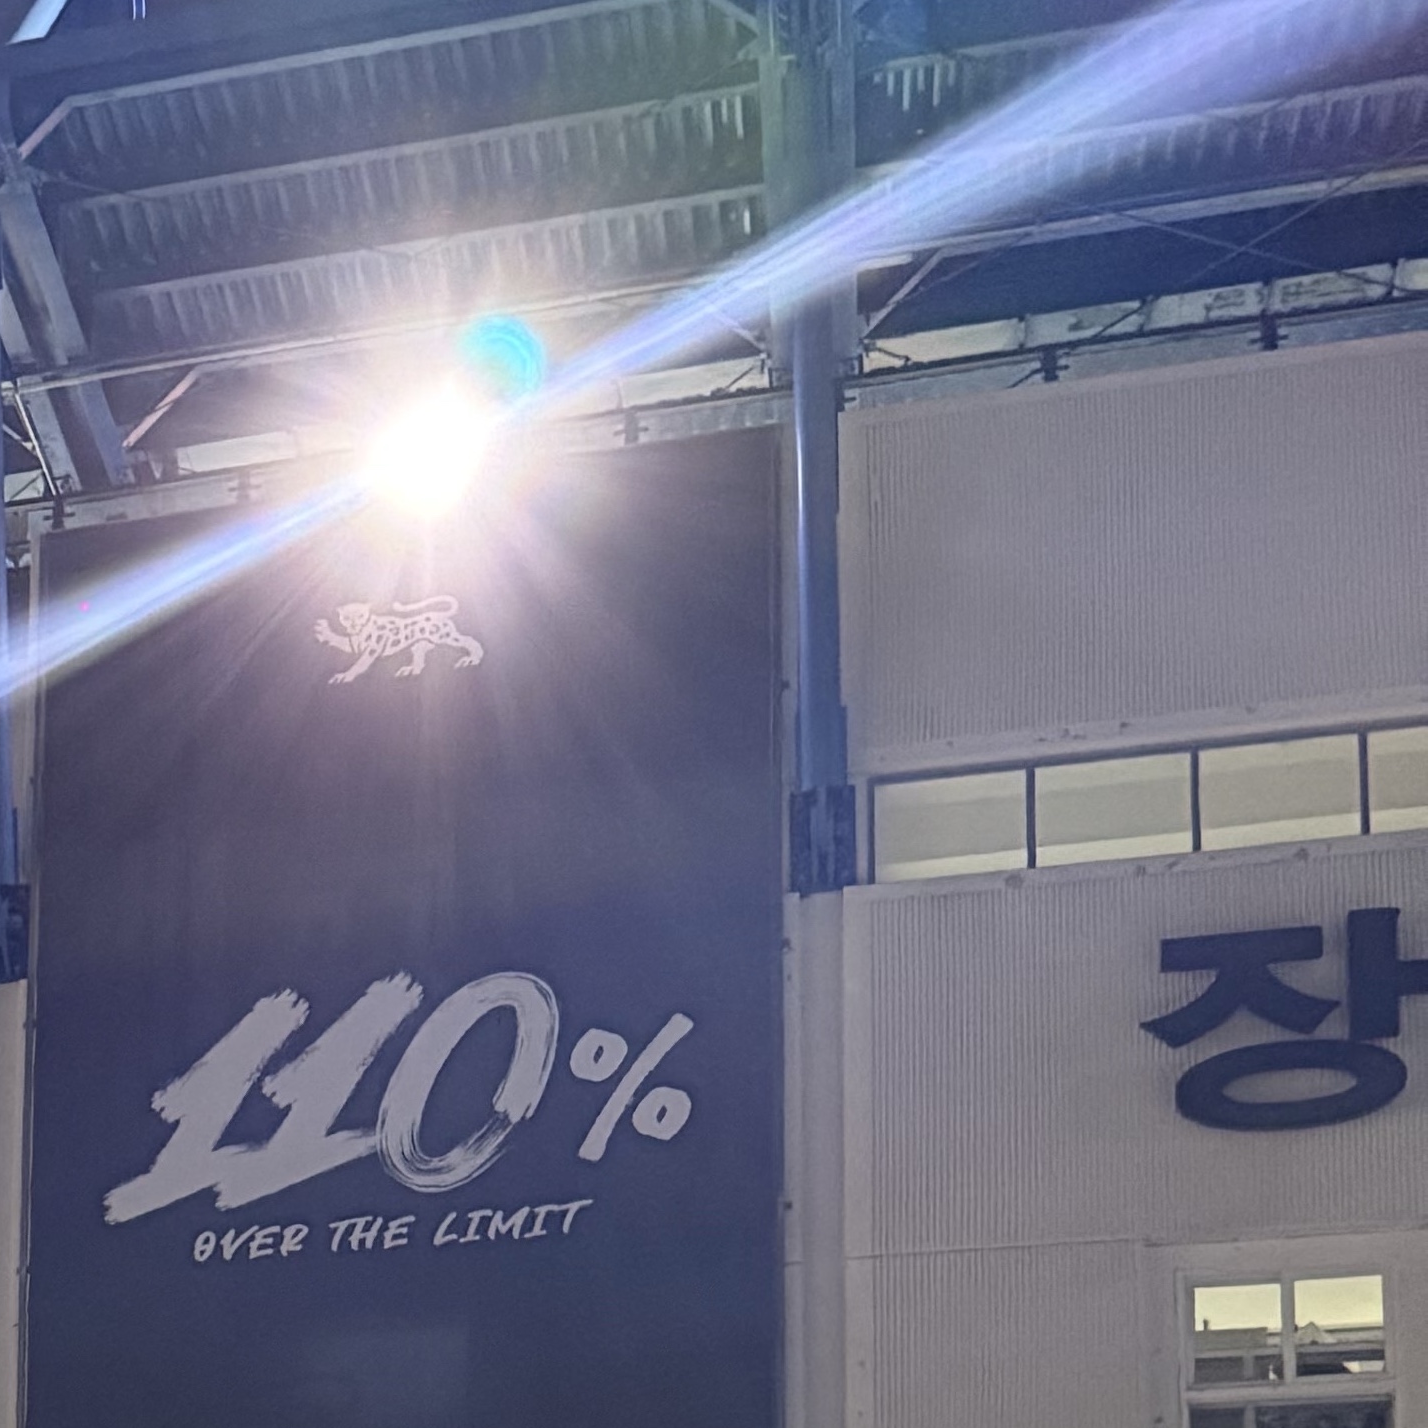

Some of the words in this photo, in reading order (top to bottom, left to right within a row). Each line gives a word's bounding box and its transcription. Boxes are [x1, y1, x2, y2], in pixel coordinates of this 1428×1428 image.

[102, 970, 695, 1225] 110%
[1139, 907, 1428, 1132] 장
[194, 1222, 305, 1263] OVER
[328, 1216, 411, 1252] THE
[435, 1200, 594, 1248] LIMIT
